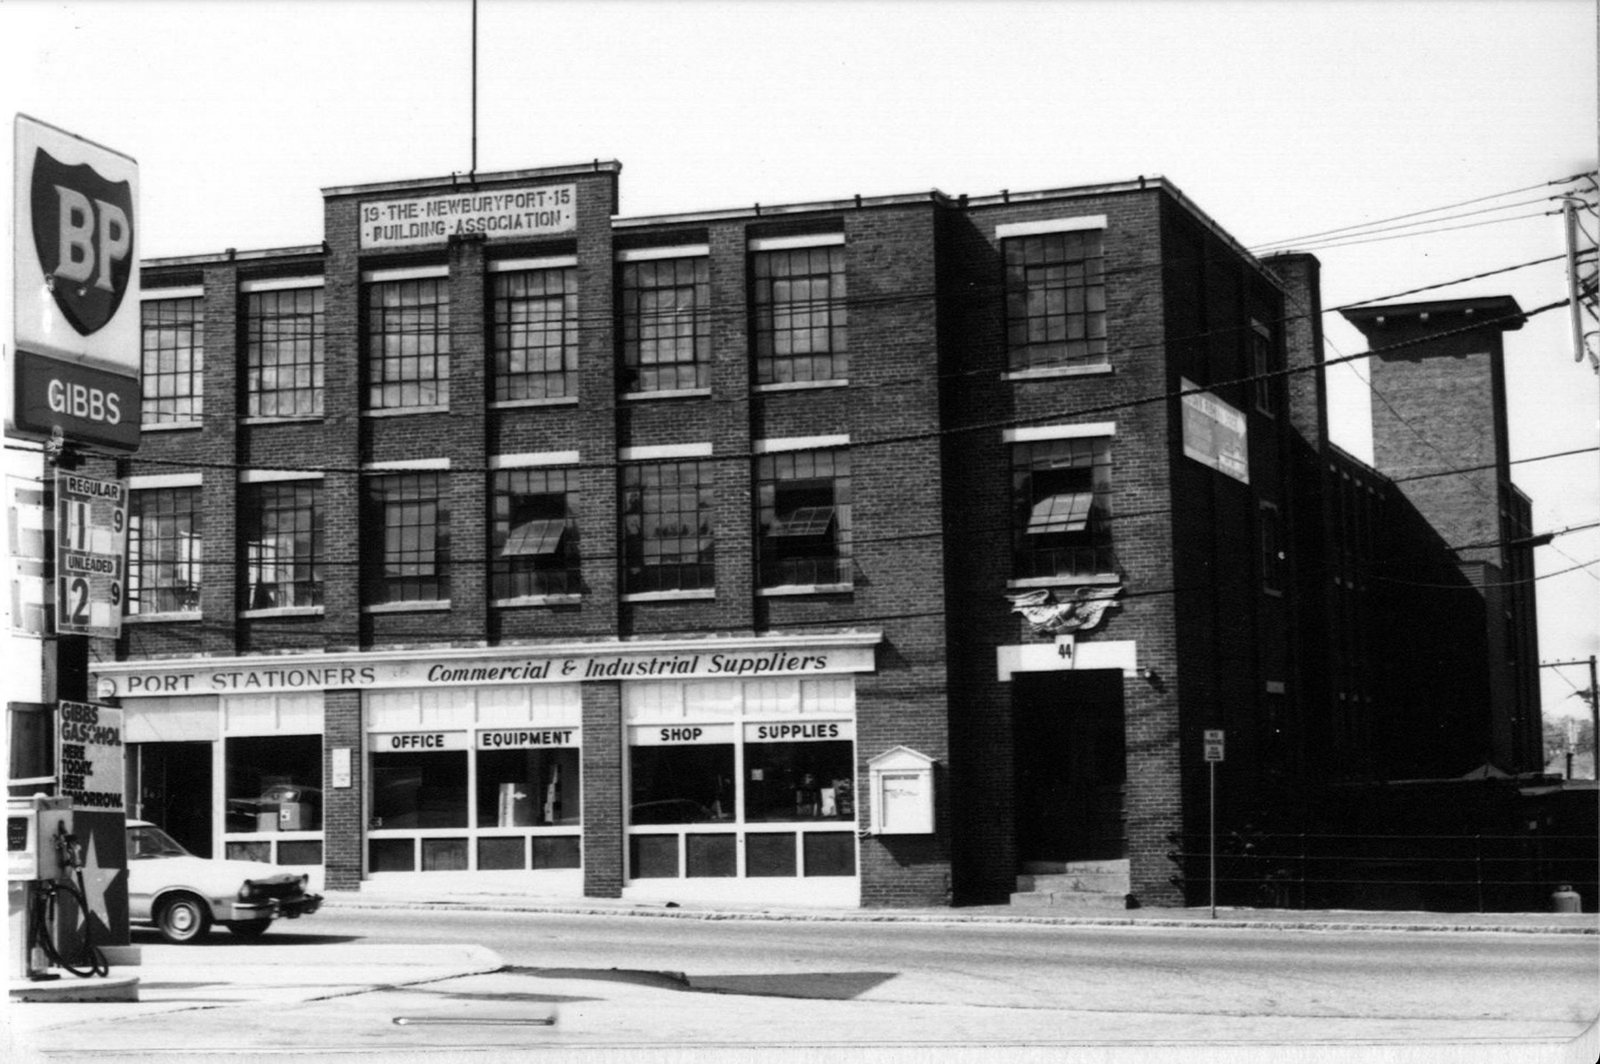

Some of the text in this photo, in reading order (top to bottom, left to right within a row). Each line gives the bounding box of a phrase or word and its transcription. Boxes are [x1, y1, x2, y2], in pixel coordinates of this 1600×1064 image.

[387, 202, 418, 221] THE
[427, 191, 546, 217] NEWBURYPORT
[554, 188, 570, 205] 15
[455, 210, 561, 235] ASSOCIATION
[55, 184, 130, 292] BP
[48, 379, 121, 425] GIBBS
[69, 477, 119, 499] REGULAR
[68, 555, 113, 573] UNLEADED
[1058, 643, 1072, 659] 44
[427, 652, 828, 682] Commercial & Industrial Suppliers
[128, 667, 376, 693] PORT STATIONERS
[61, 702, 99, 725] GIBBS
[391, 734, 445, 749] OFFICE
[482, 731, 573, 747] EQUIPMENT
[660, 728, 702, 741] SHOP
[758, 724, 839, 739] SUPPLIES
